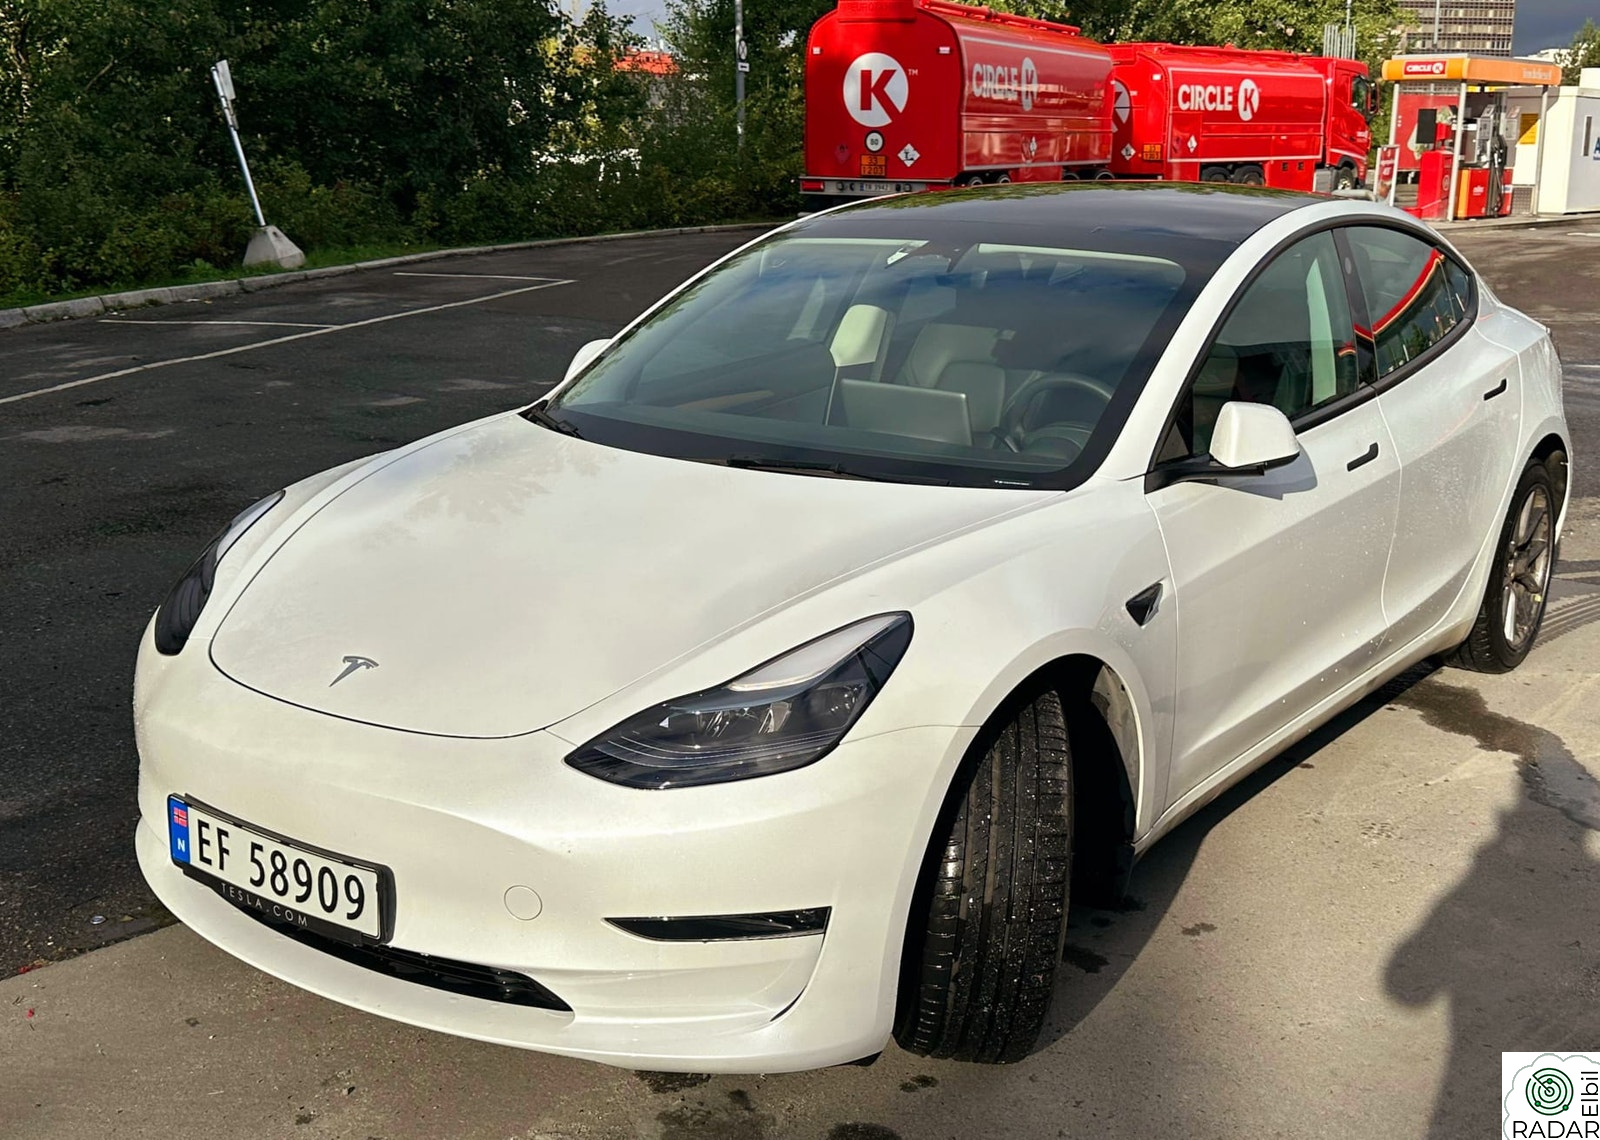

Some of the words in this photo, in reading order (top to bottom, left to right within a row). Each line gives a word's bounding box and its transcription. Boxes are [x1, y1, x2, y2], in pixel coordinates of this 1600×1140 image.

[858, 66, 904, 125] K
[972, 63, 1018, 100] CIRCLE
[1023, 62, 1036, 108] K
[1178, 84, 1233, 111] CIRCLE
[1240, 82, 1258, 120] K
[863, 166, 883, 174] 1203
[177, 837, 186, 853] N
[197, 819, 230, 871] EF
[250, 841, 365, 921] 58909
[221, 882, 308, 928] TESLA.COM
